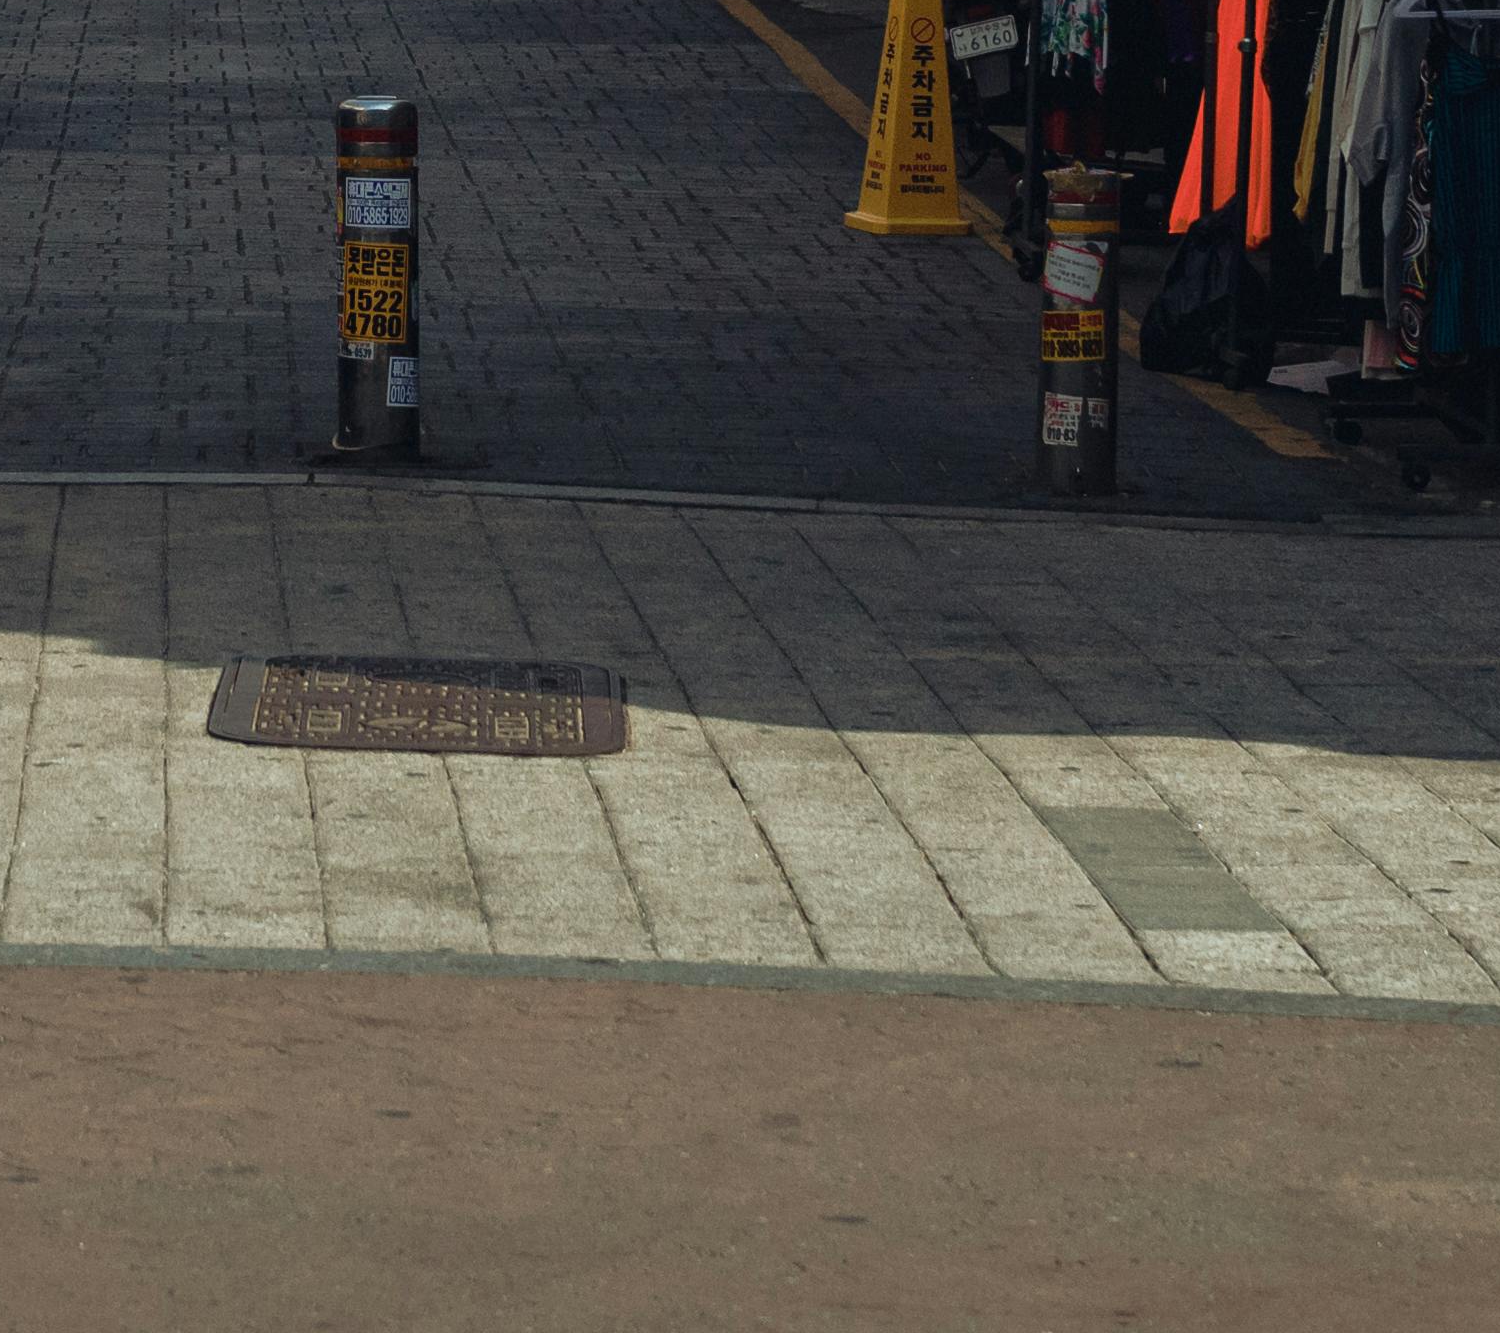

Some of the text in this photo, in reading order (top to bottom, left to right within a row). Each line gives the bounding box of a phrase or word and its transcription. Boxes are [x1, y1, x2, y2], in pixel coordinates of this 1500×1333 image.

[970, 28, 1013, 51] 6160
[910, 43, 935, 142] 주차금지
[899, 163, 948, 173] PARKING
[915, 152, 931, 161] NO
[348, 248, 405, 276] 못받은돈
[347, 290, 403, 313] 1522
[345, 314, 402, 338] 4780
